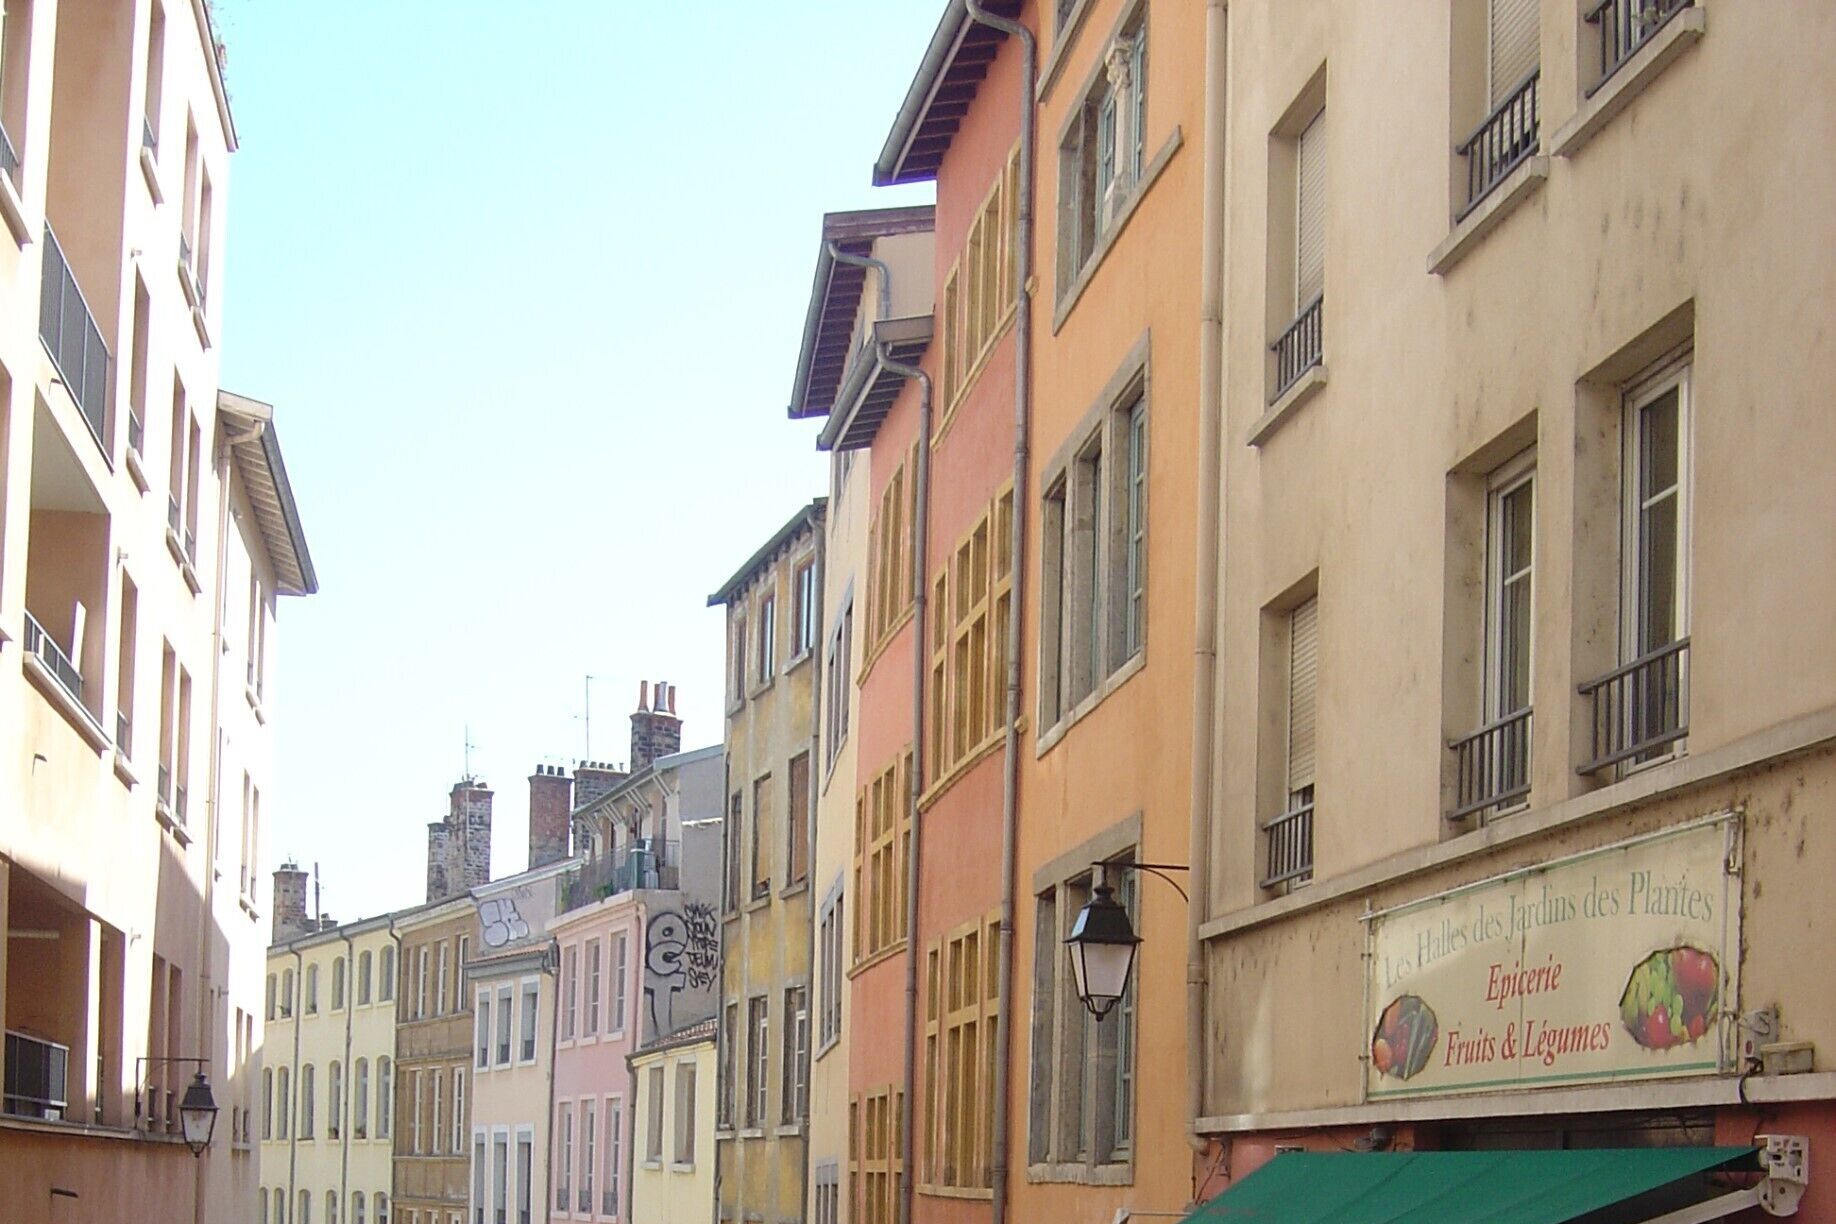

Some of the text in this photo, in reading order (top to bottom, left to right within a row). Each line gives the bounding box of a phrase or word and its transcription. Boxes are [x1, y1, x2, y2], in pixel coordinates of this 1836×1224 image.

[1384, 870, 1715, 990] Les Halles des Jardins des Plantes
[1485, 953, 1562, 1010] Epicerie
[1444, 1018, 1611, 1067] Fruits & Légumes
